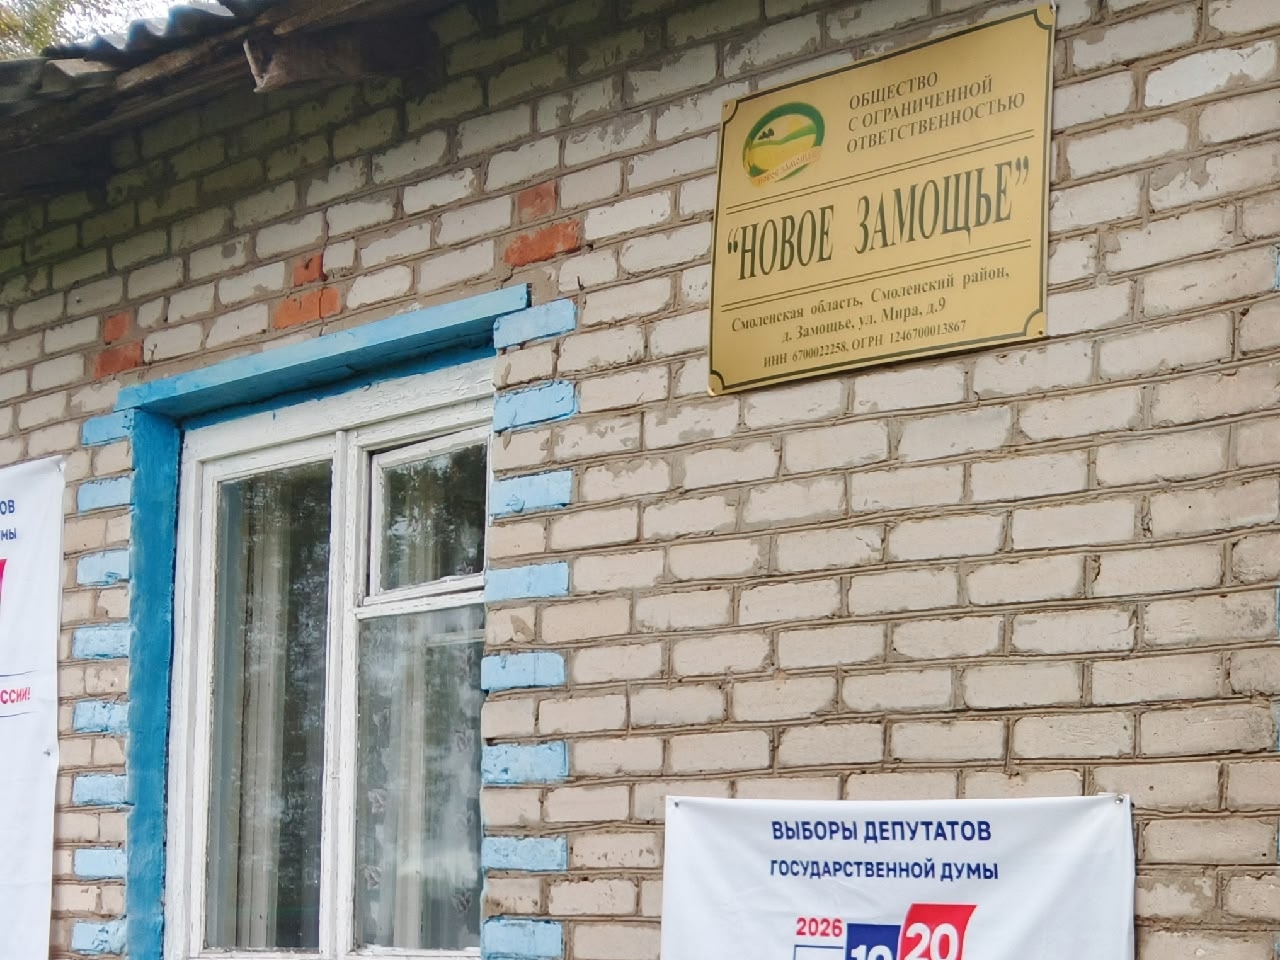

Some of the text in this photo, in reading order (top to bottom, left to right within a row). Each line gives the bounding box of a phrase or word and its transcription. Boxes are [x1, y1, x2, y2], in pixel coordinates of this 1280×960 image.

[848, 75, 993, 132] С ОГРАНИЧЕННОЙ
[849, 71, 938, 110] ОБЩЕСТВО
[846, 92, 1025, 153] ОТВЕТСТВЕННОСТЬЮ
[731, 266, 1010, 332] Смоленская область, Смоленский район,
[881, 304, 923, 322] Мира,
[763, 352, 787, 368] ИНН
[851, 334, 883, 351] ОГРН
[0, 527, 17, 541] МЫ
[771, 820, 992, 844] ВЫБОРЫ ДЕПУТАТОВ
[770, 857, 999, 882] ГОСУДАРСТВЕННОЙ ДУМЫ
[795, 917, 843, 937] 2026
